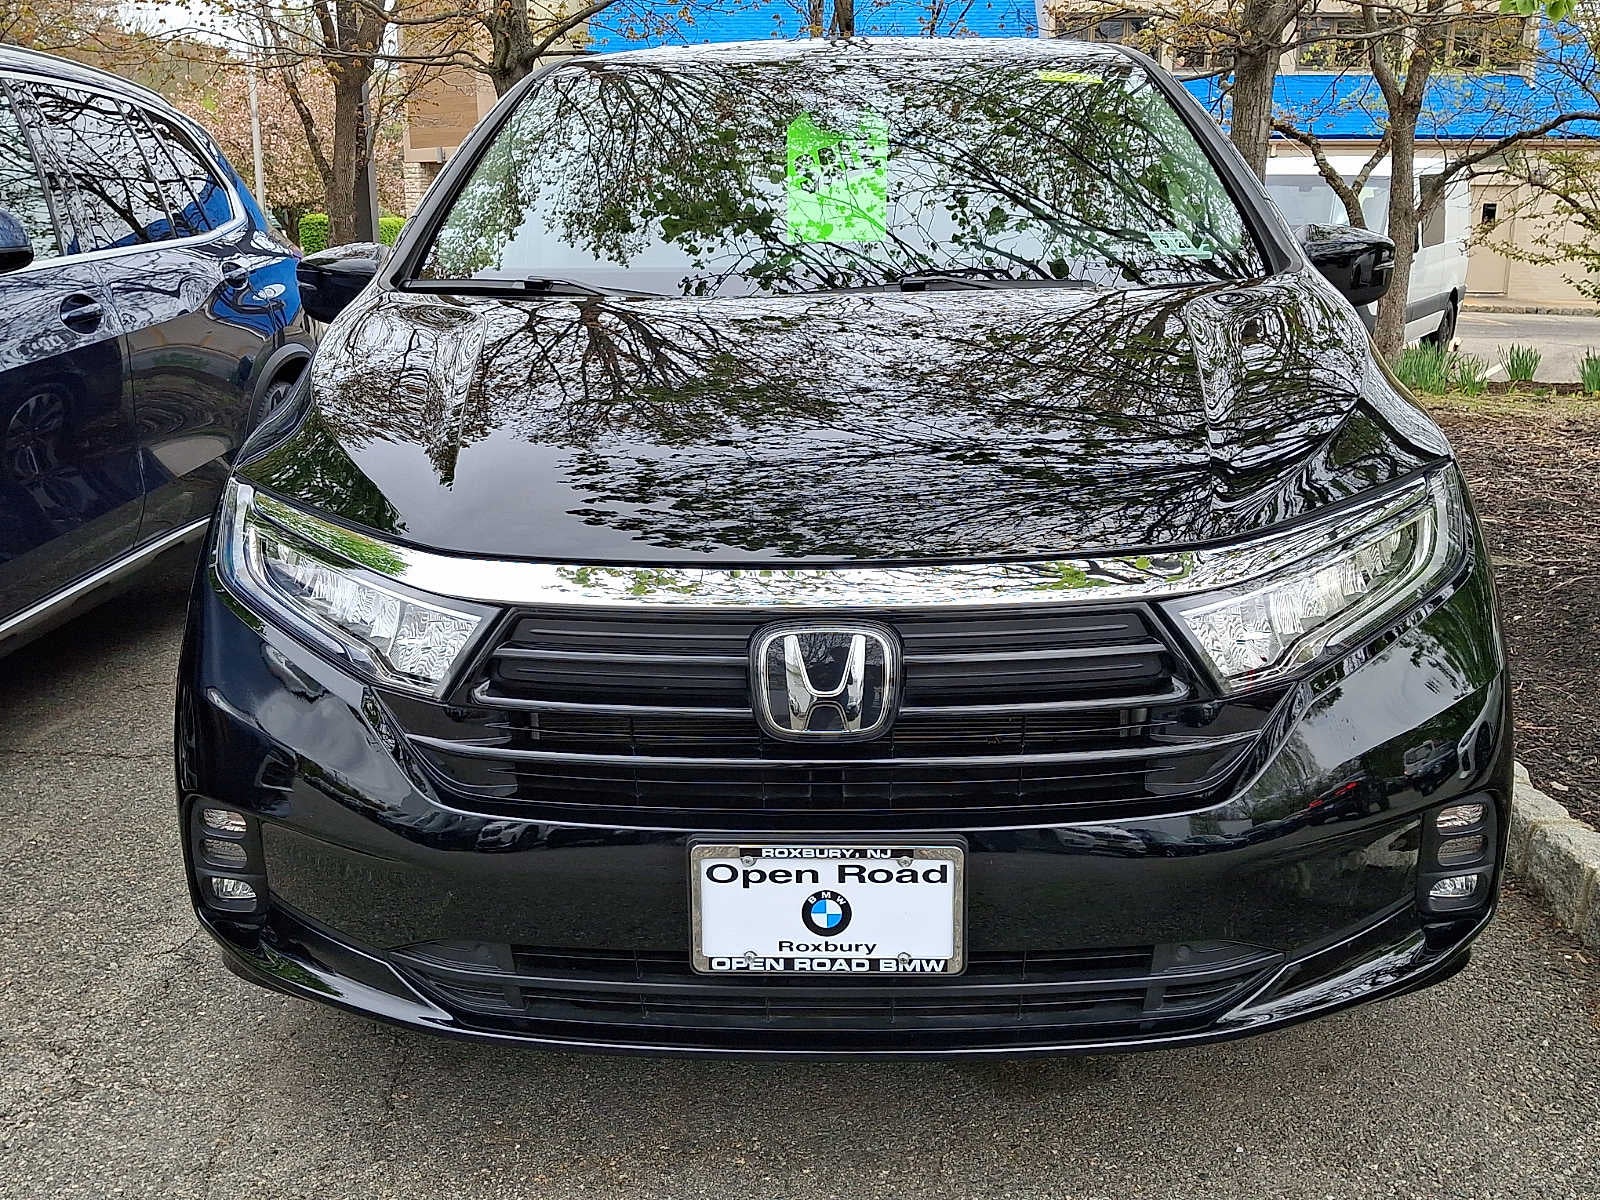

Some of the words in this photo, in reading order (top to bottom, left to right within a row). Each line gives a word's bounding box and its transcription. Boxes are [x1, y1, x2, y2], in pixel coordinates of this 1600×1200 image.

[761, 848, 860, 859] ROXBURY,
[866, 849, 892, 859] NJ
[706, 863, 819, 888] Open
[837, 864, 948, 884] Road
[808, 891, 847, 906] BMW
[778, 940, 877, 955] Roxbury
[711, 957, 785, 971] OPEN
[793, 958, 870, 972] ROAD
[879, 959, 945, 973] BMW
